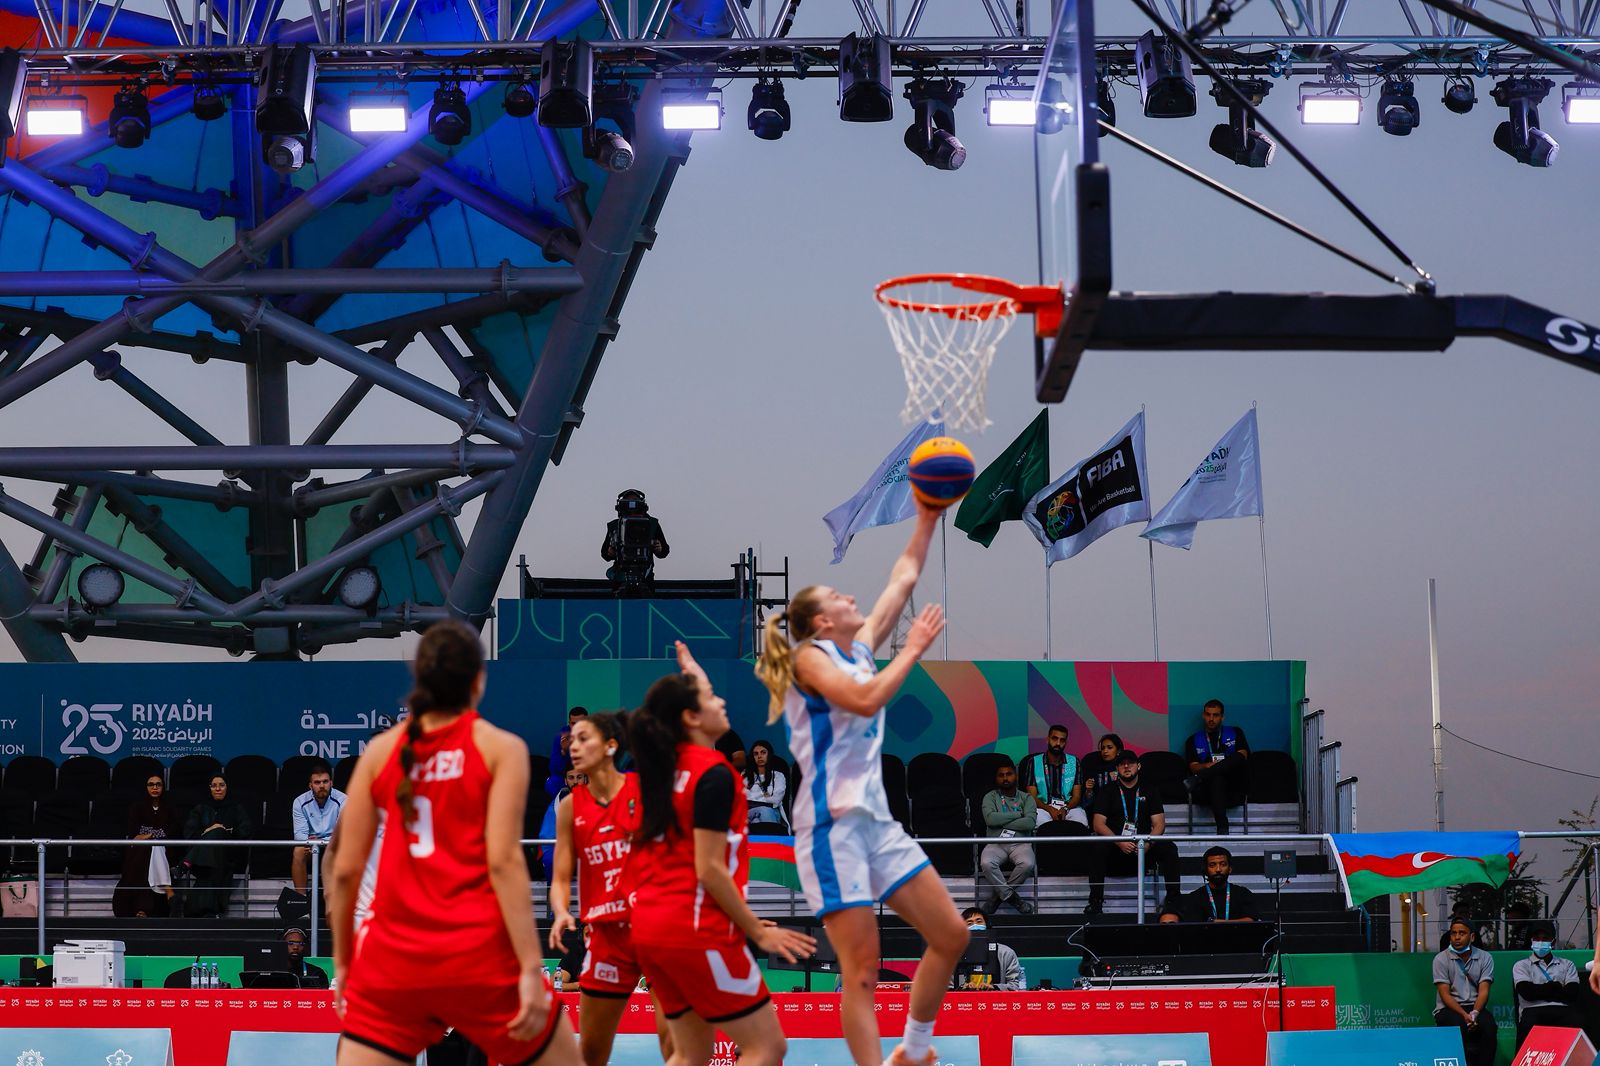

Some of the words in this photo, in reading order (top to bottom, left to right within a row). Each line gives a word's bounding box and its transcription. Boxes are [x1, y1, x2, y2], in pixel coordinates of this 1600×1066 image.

[1086, 449, 1125, 489] FIBA
[1106, 485, 1136, 500] Basketball
[132, 700, 212, 725] RIYADH
[132, 728, 166, 740] 2025
[168, 727, 212, 743] الرياض
[300, 740, 350, 758] ONE
